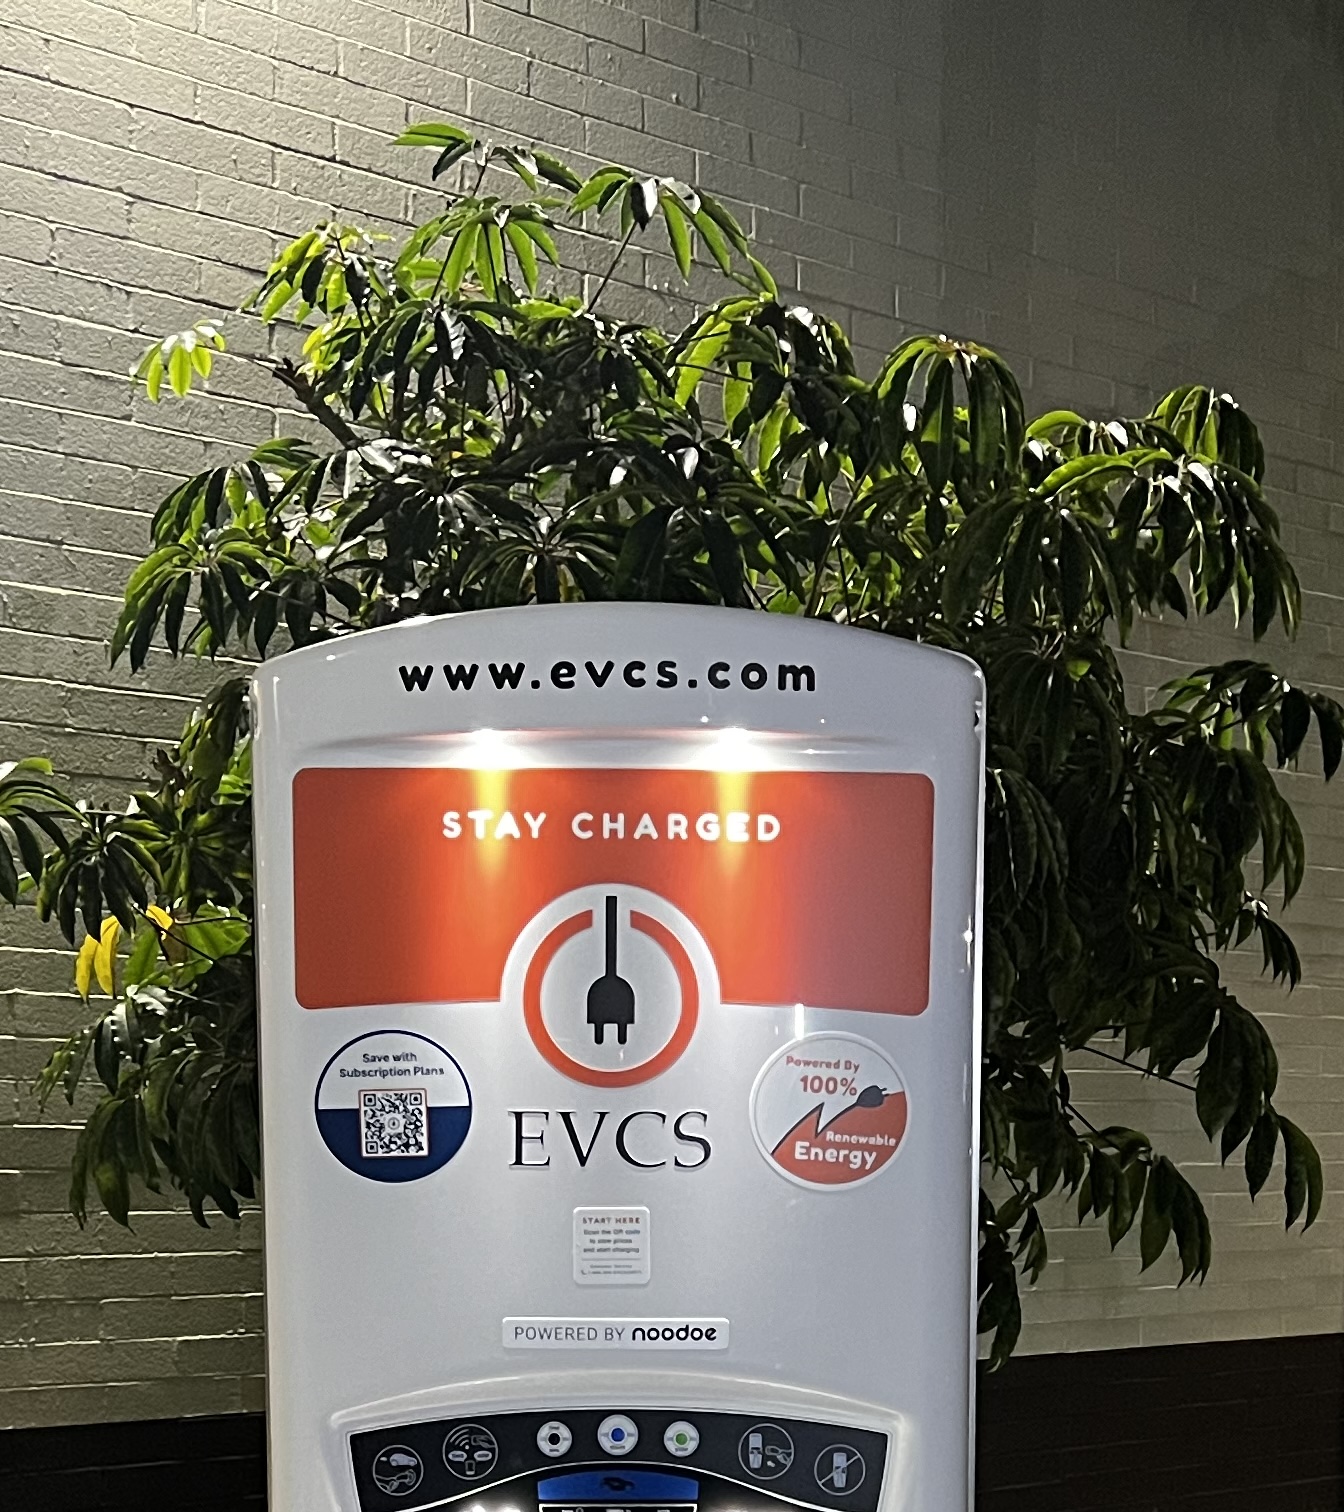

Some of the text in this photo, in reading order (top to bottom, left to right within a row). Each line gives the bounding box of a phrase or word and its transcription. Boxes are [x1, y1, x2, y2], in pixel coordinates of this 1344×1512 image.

[399, 657, 817, 693] www.evcs.com
[442, 811, 781, 843] STAY CHARGED
[362, 1052, 417, 1063] Save with
[786, 1056, 860, 1073] Powered By
[339, 1065, 445, 1079] Subscription Plans
[800, 1075, 858, 1096] 100%
[509, 1110, 712, 1171] EVCS
[825, 1131, 897, 1147] Renewable
[794, 1140, 877, 1170] Energy
[514, 1324, 717, 1341] POWERED BY noodoe
